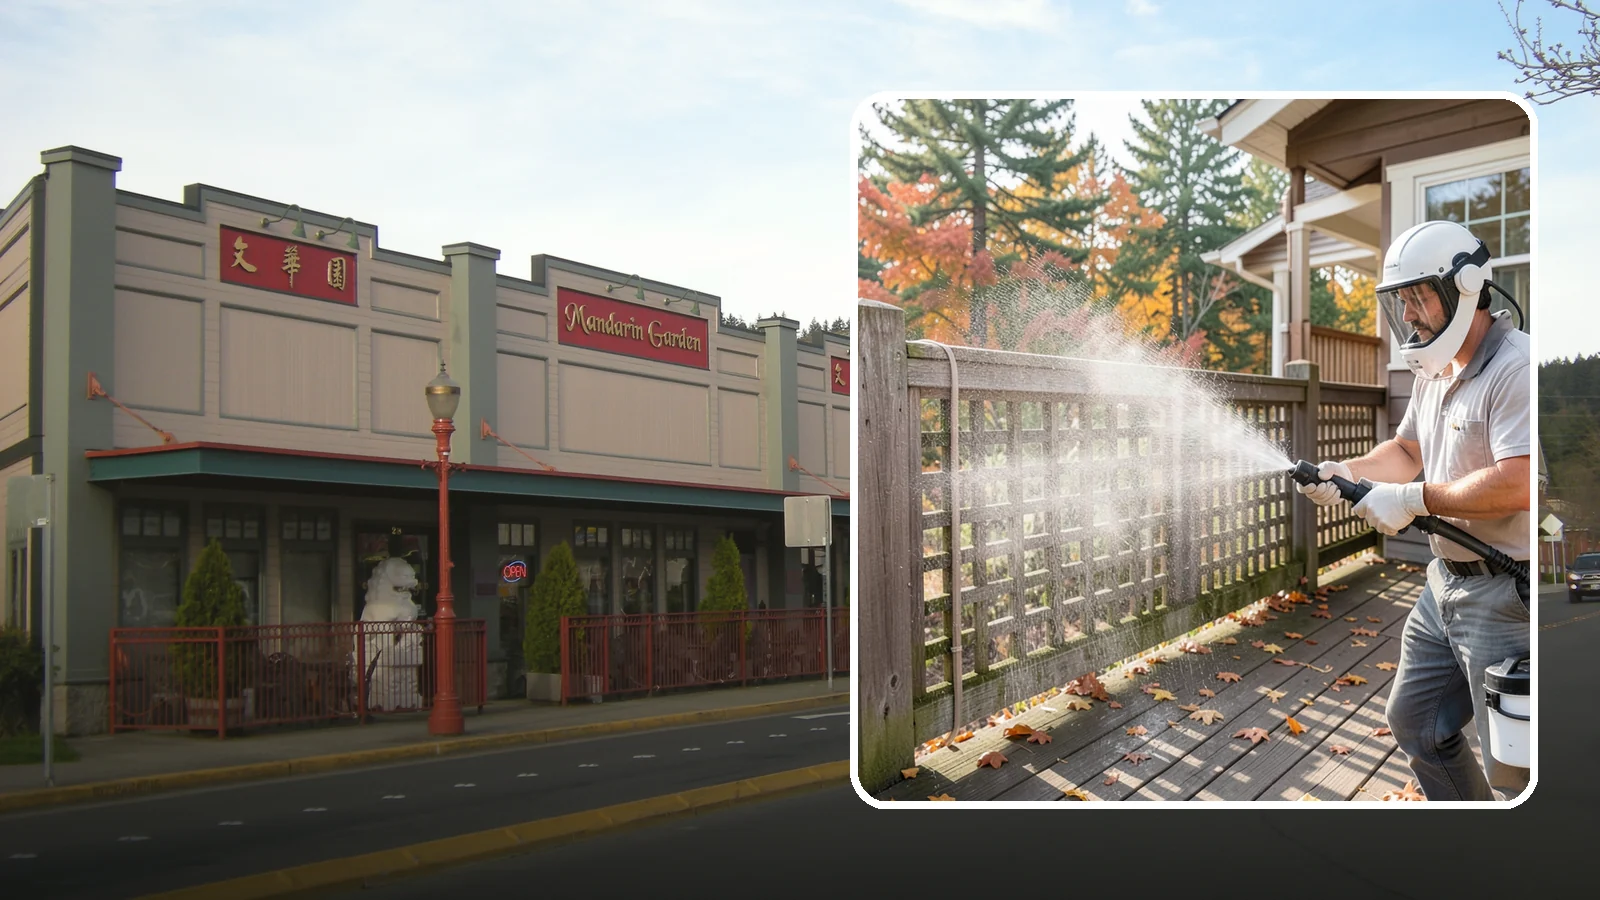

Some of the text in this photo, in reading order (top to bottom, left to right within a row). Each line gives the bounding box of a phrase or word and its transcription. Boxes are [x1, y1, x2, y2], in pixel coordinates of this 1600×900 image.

[231, 235, 346, 291] 文華園
[564, 302, 701, 352] Mandarin Garden
[503, 565, 527, 578] OPEN
